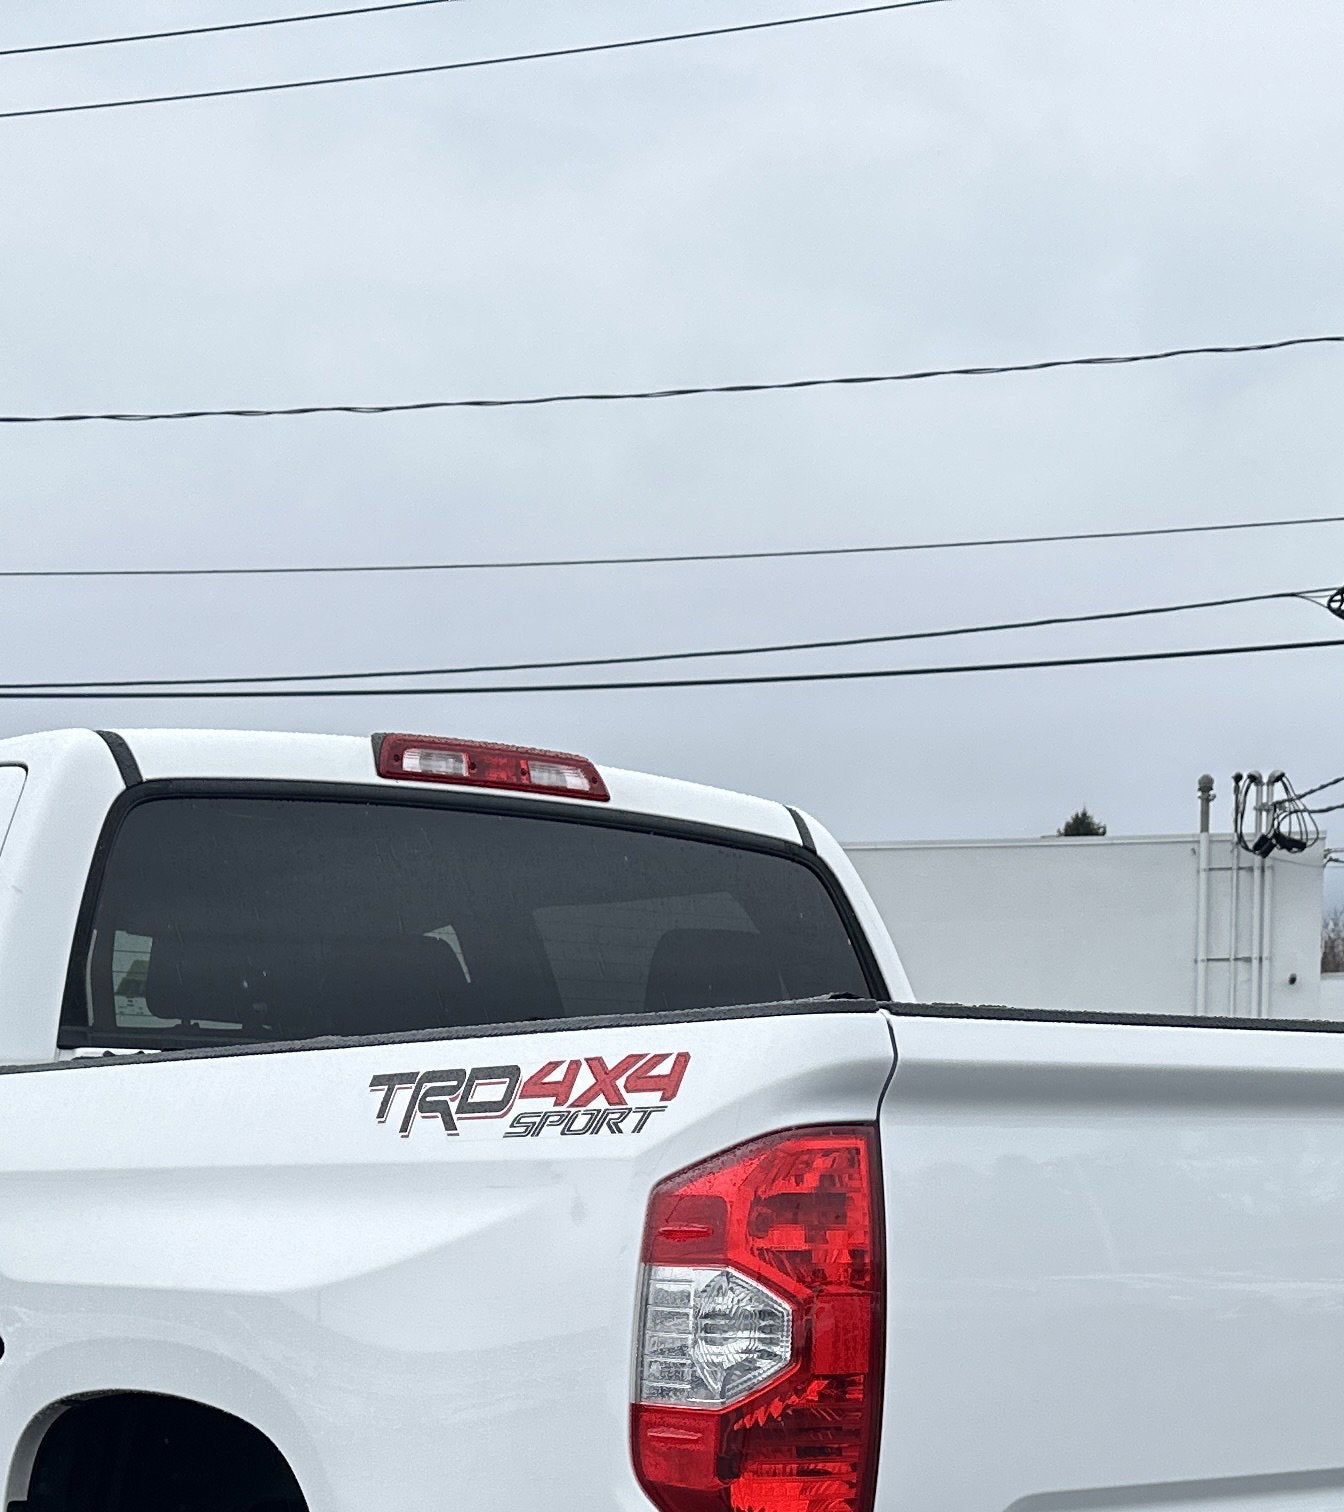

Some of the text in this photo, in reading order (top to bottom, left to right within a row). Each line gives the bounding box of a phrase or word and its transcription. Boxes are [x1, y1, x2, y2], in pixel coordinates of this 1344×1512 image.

[368, 1051, 692, 1138] TRD 4X4
[502, 1105, 669, 1138] SPORT
